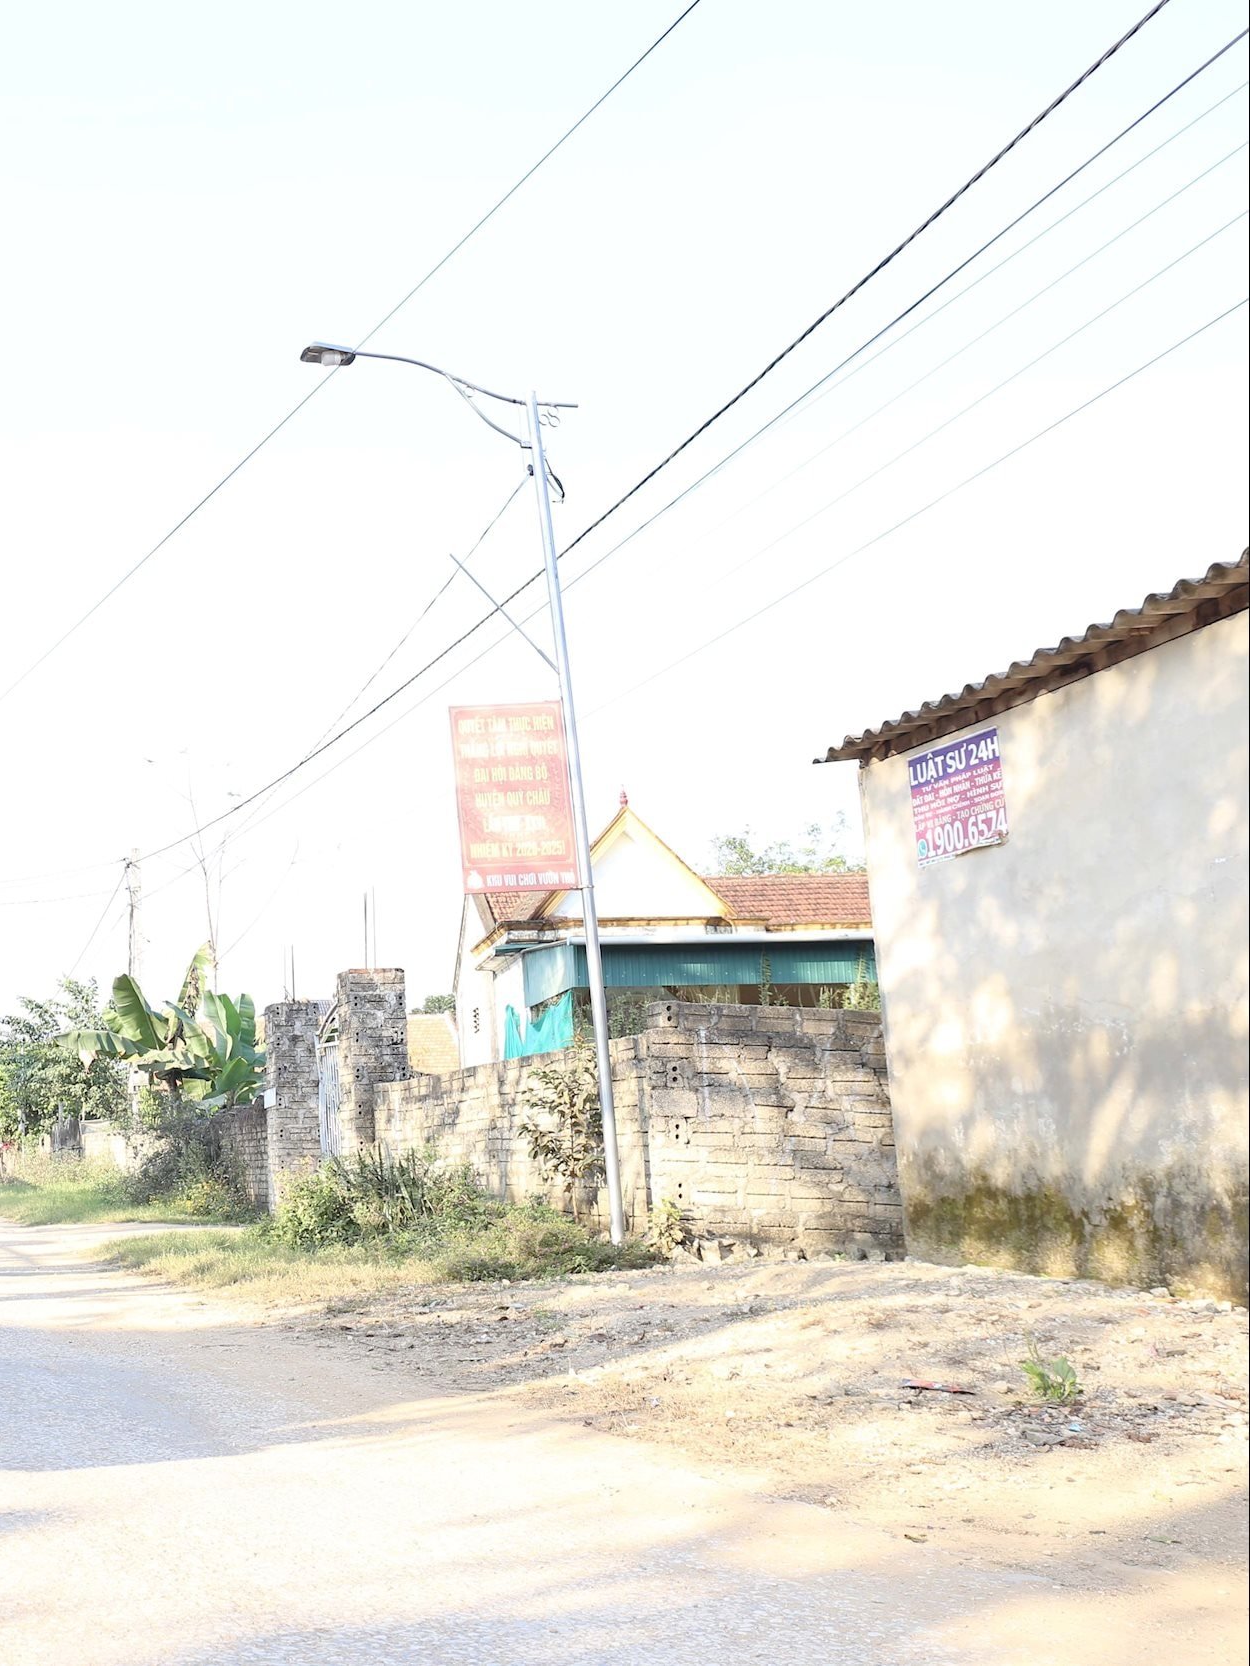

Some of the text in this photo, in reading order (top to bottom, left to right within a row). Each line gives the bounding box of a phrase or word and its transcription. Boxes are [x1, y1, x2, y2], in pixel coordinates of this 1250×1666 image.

[910, 736, 999, 785] LUẬT SƯ 24H
[926, 808, 1008, 857] 1900.6574
[486, 874, 502, 887] KHU
[505, 873, 517, 887] VUI
